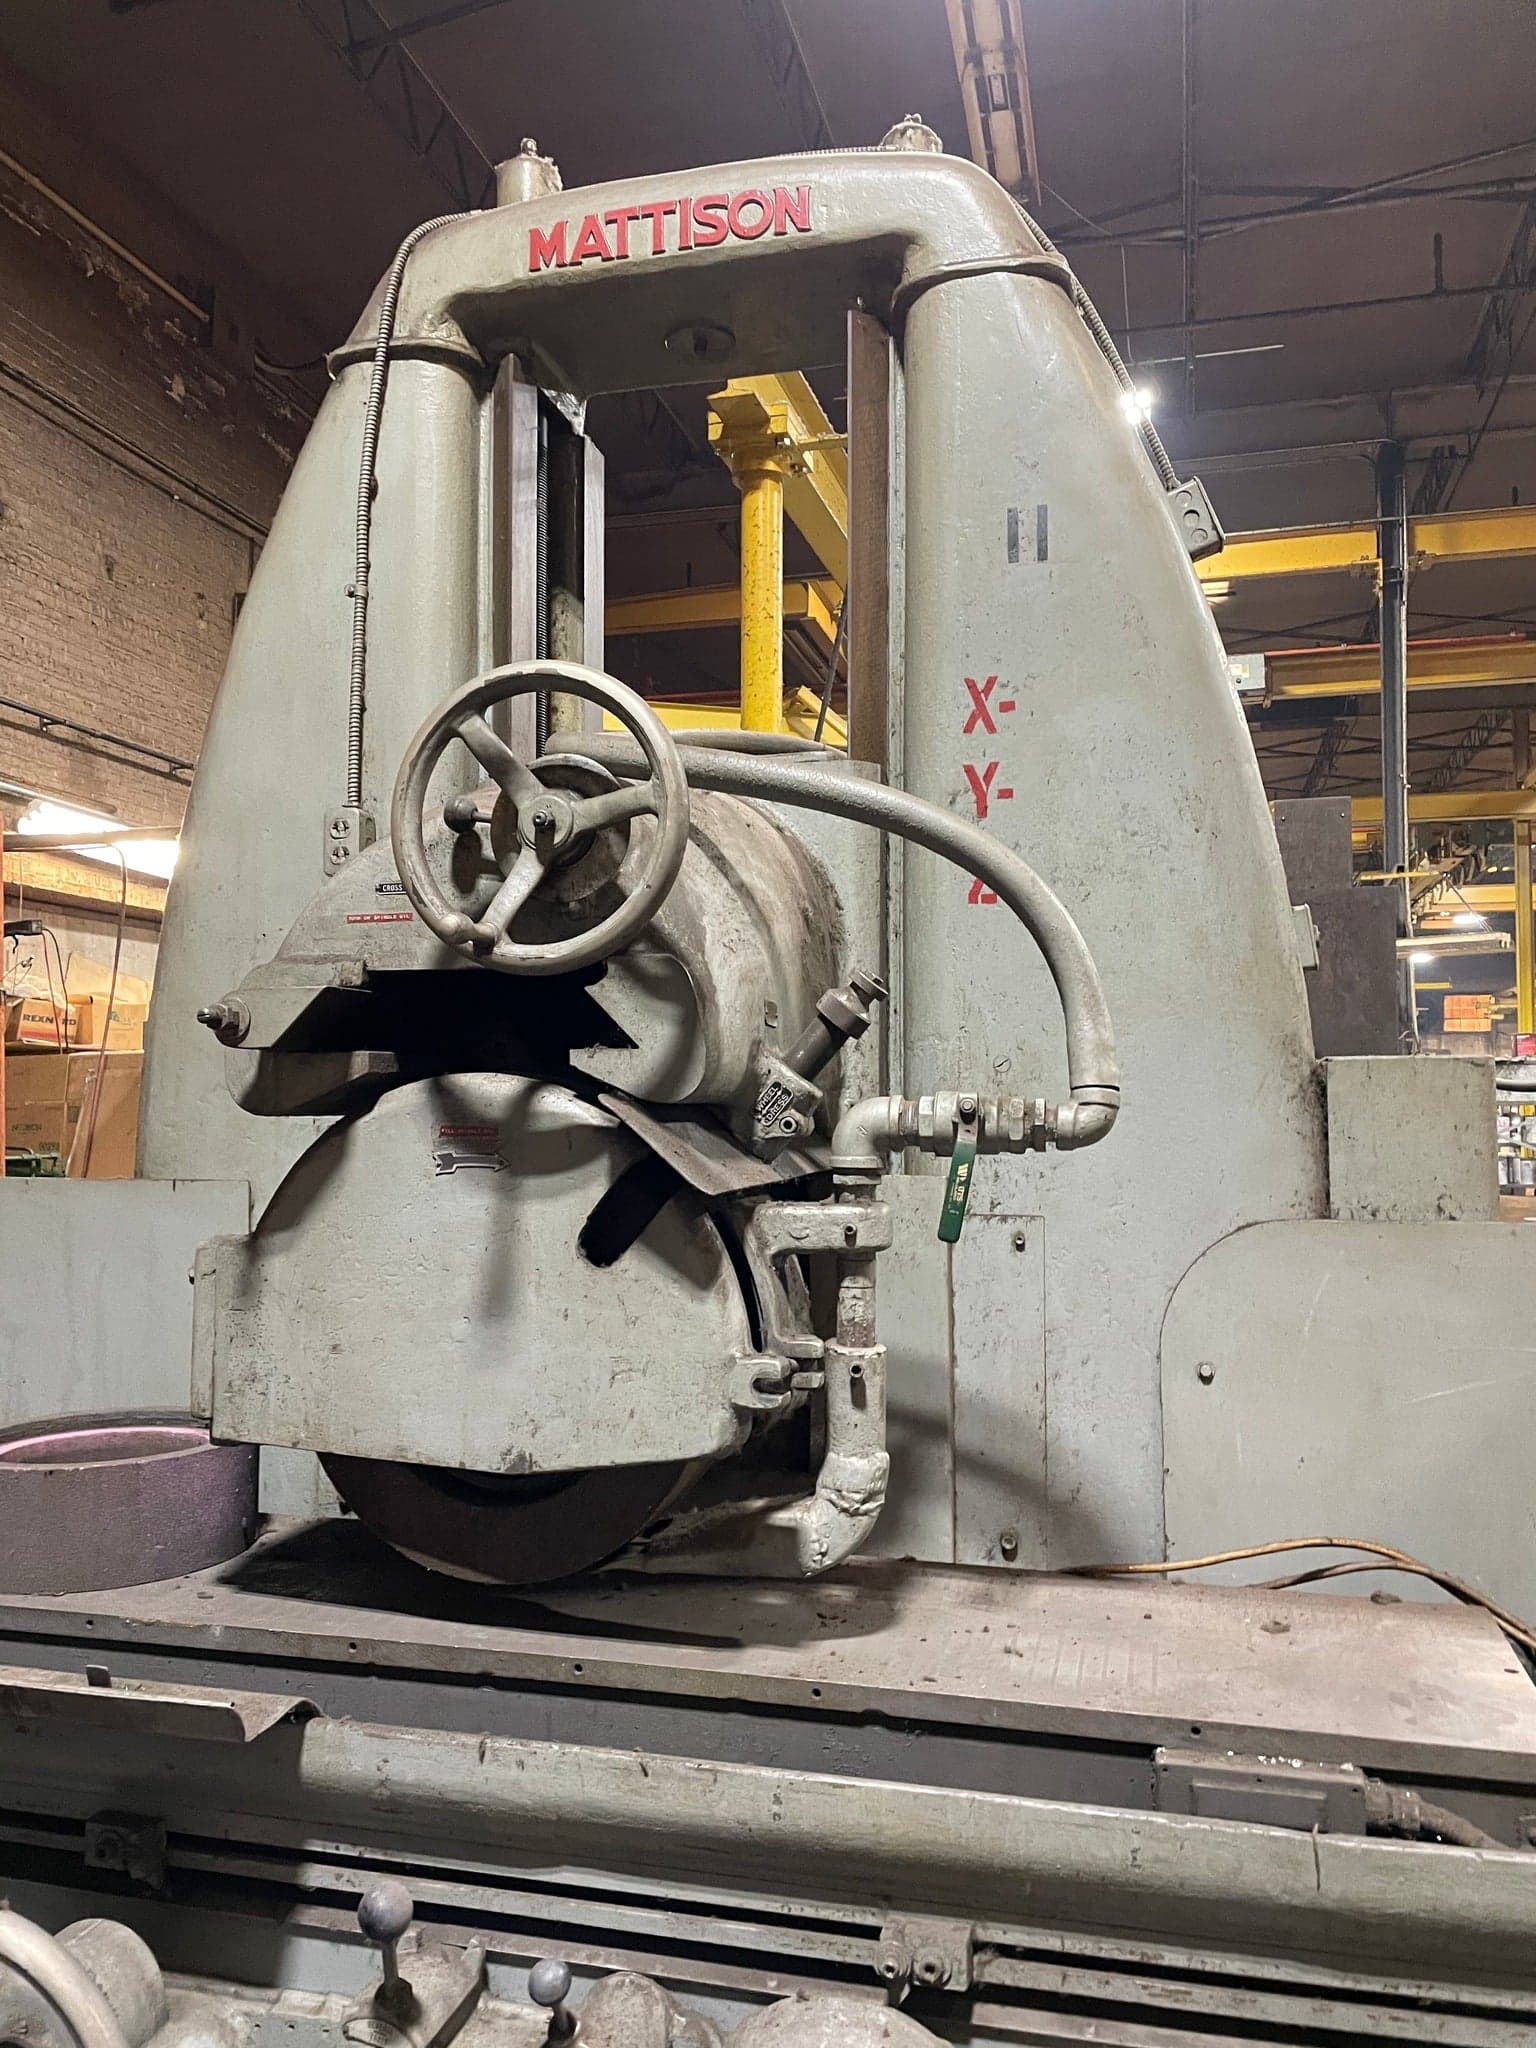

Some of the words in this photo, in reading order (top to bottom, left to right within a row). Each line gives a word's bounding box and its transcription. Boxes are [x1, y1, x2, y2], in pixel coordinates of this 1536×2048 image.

[528, 184, 812, 272] MATTISON
[382, 884, 403, 892] CROSS
[756, 1086, 779, 1111] WHEEL
[766, 1094, 789, 1120] DRESS
